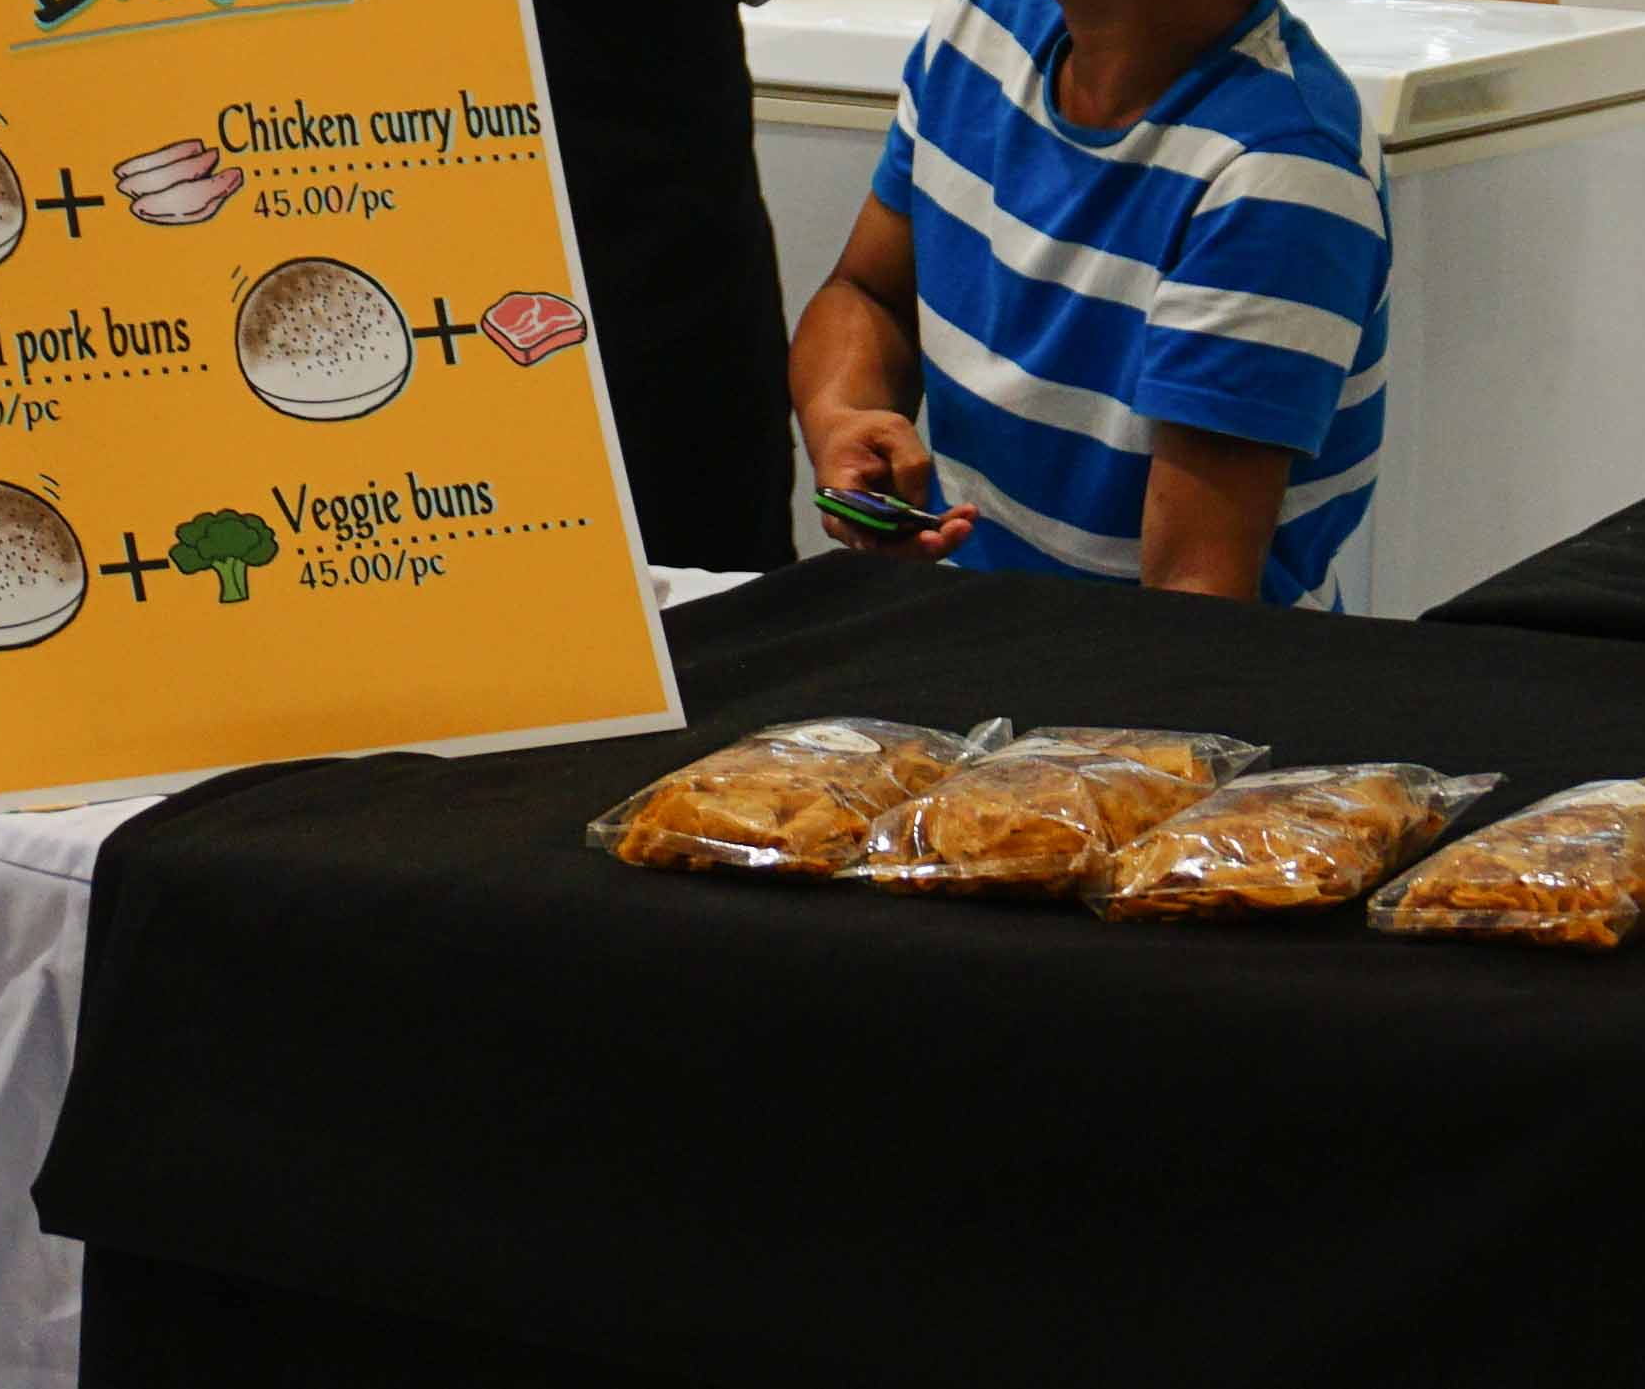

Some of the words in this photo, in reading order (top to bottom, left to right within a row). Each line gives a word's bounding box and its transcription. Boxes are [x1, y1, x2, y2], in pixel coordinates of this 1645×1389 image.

[217, 98, 360, 154] Chicken
[370, 106, 452, 153] curry
[458, 89, 542, 139] buns
[254, 183, 396, 220] 45.00/pc
[15, 309, 98, 379] pork
[102, 306, 192, 358] buns
[271, 479, 402, 542] Veggie
[405, 471, 494, 521] buns
[299, 549, 446, 589] 45.00/pc
